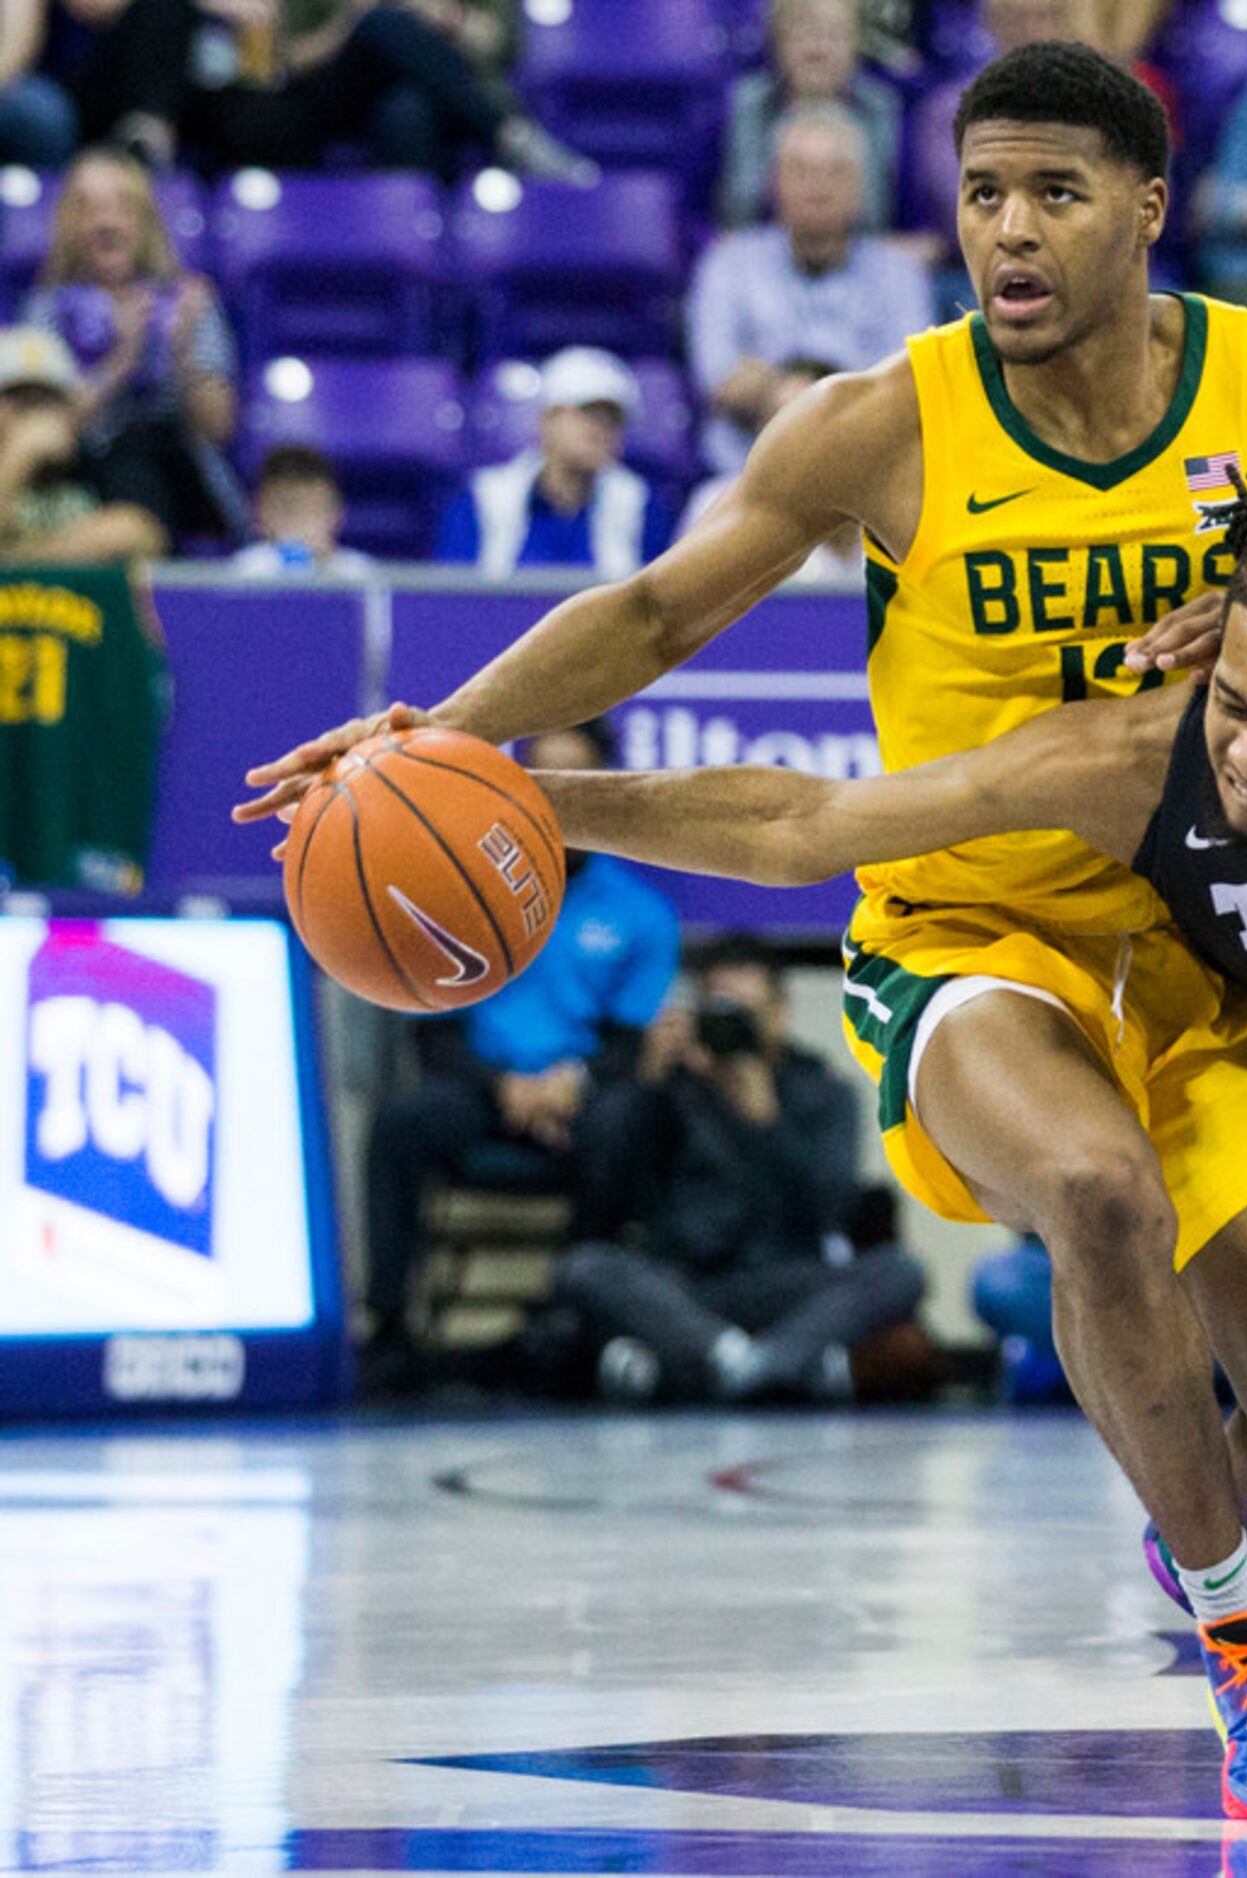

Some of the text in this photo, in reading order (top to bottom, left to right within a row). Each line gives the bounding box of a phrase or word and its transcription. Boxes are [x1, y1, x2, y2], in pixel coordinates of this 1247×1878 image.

[624, 706, 884, 778] ilton
[477, 822, 548, 937] ELITE
[30, 994, 213, 1208] TCU
